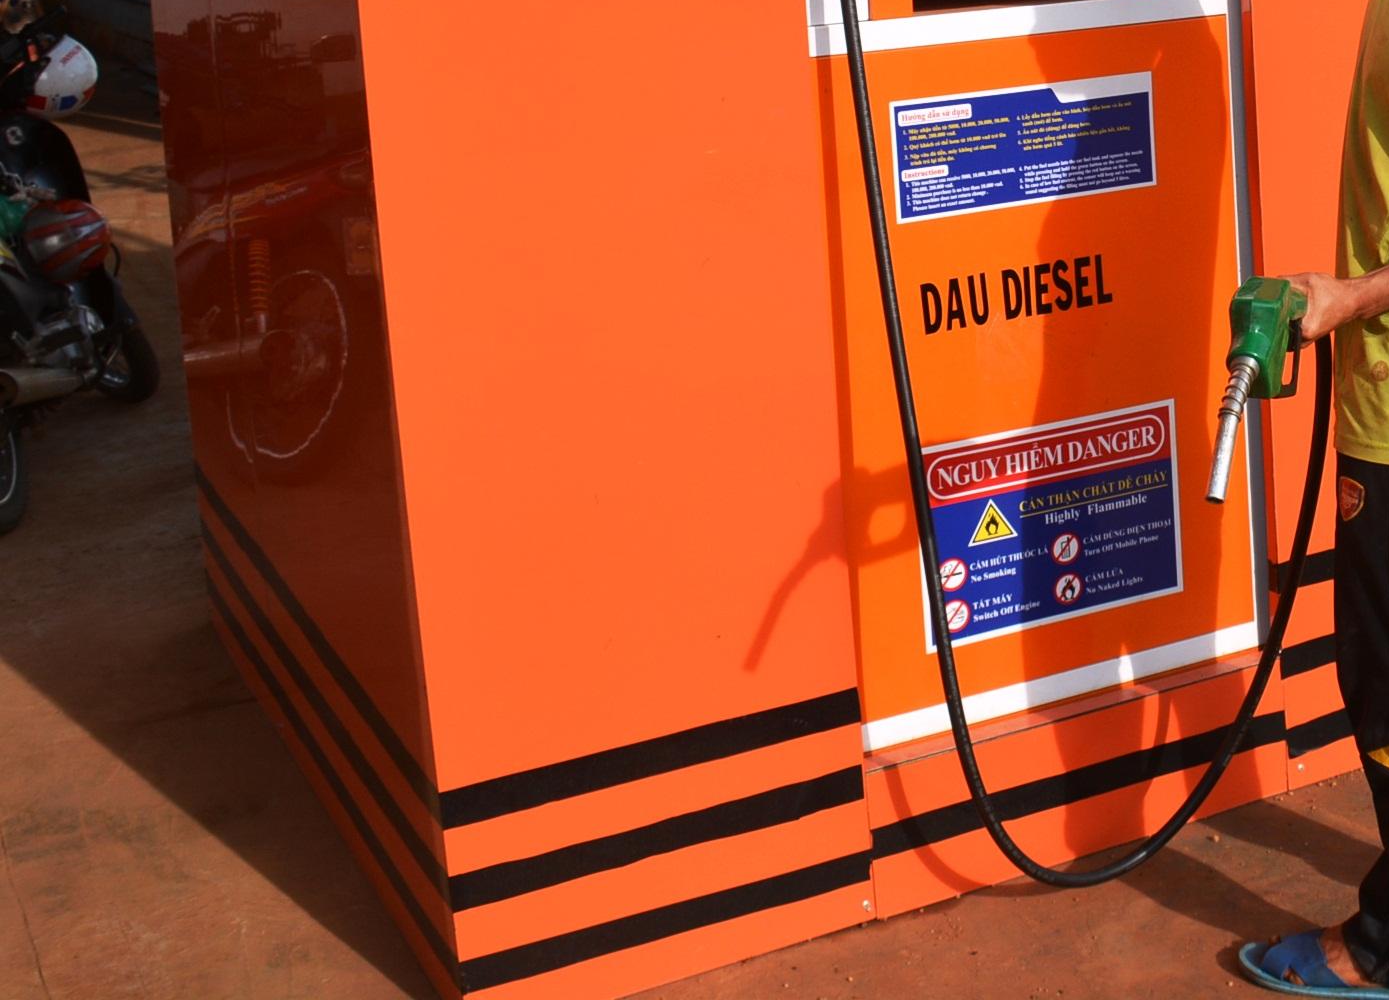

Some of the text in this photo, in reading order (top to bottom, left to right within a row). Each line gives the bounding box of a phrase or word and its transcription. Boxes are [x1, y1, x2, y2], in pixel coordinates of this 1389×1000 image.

[904, 168, 945, 179] Instructions
[920, 254, 1113, 335] DAU DIESEL
[937, 456, 1000, 490] NGUY
[1068, 425, 1157, 464] DANGER
[1045, 493, 1148, 525] Highly Flammable
[1084, 534, 1159, 557] Turn Off Mobile Phone
[970, 567, 1017, 583] No Smoking
[1086, 576, 1144, 594] No Naked Lights
[973, 600, 1041, 623] Switch Off Engine
